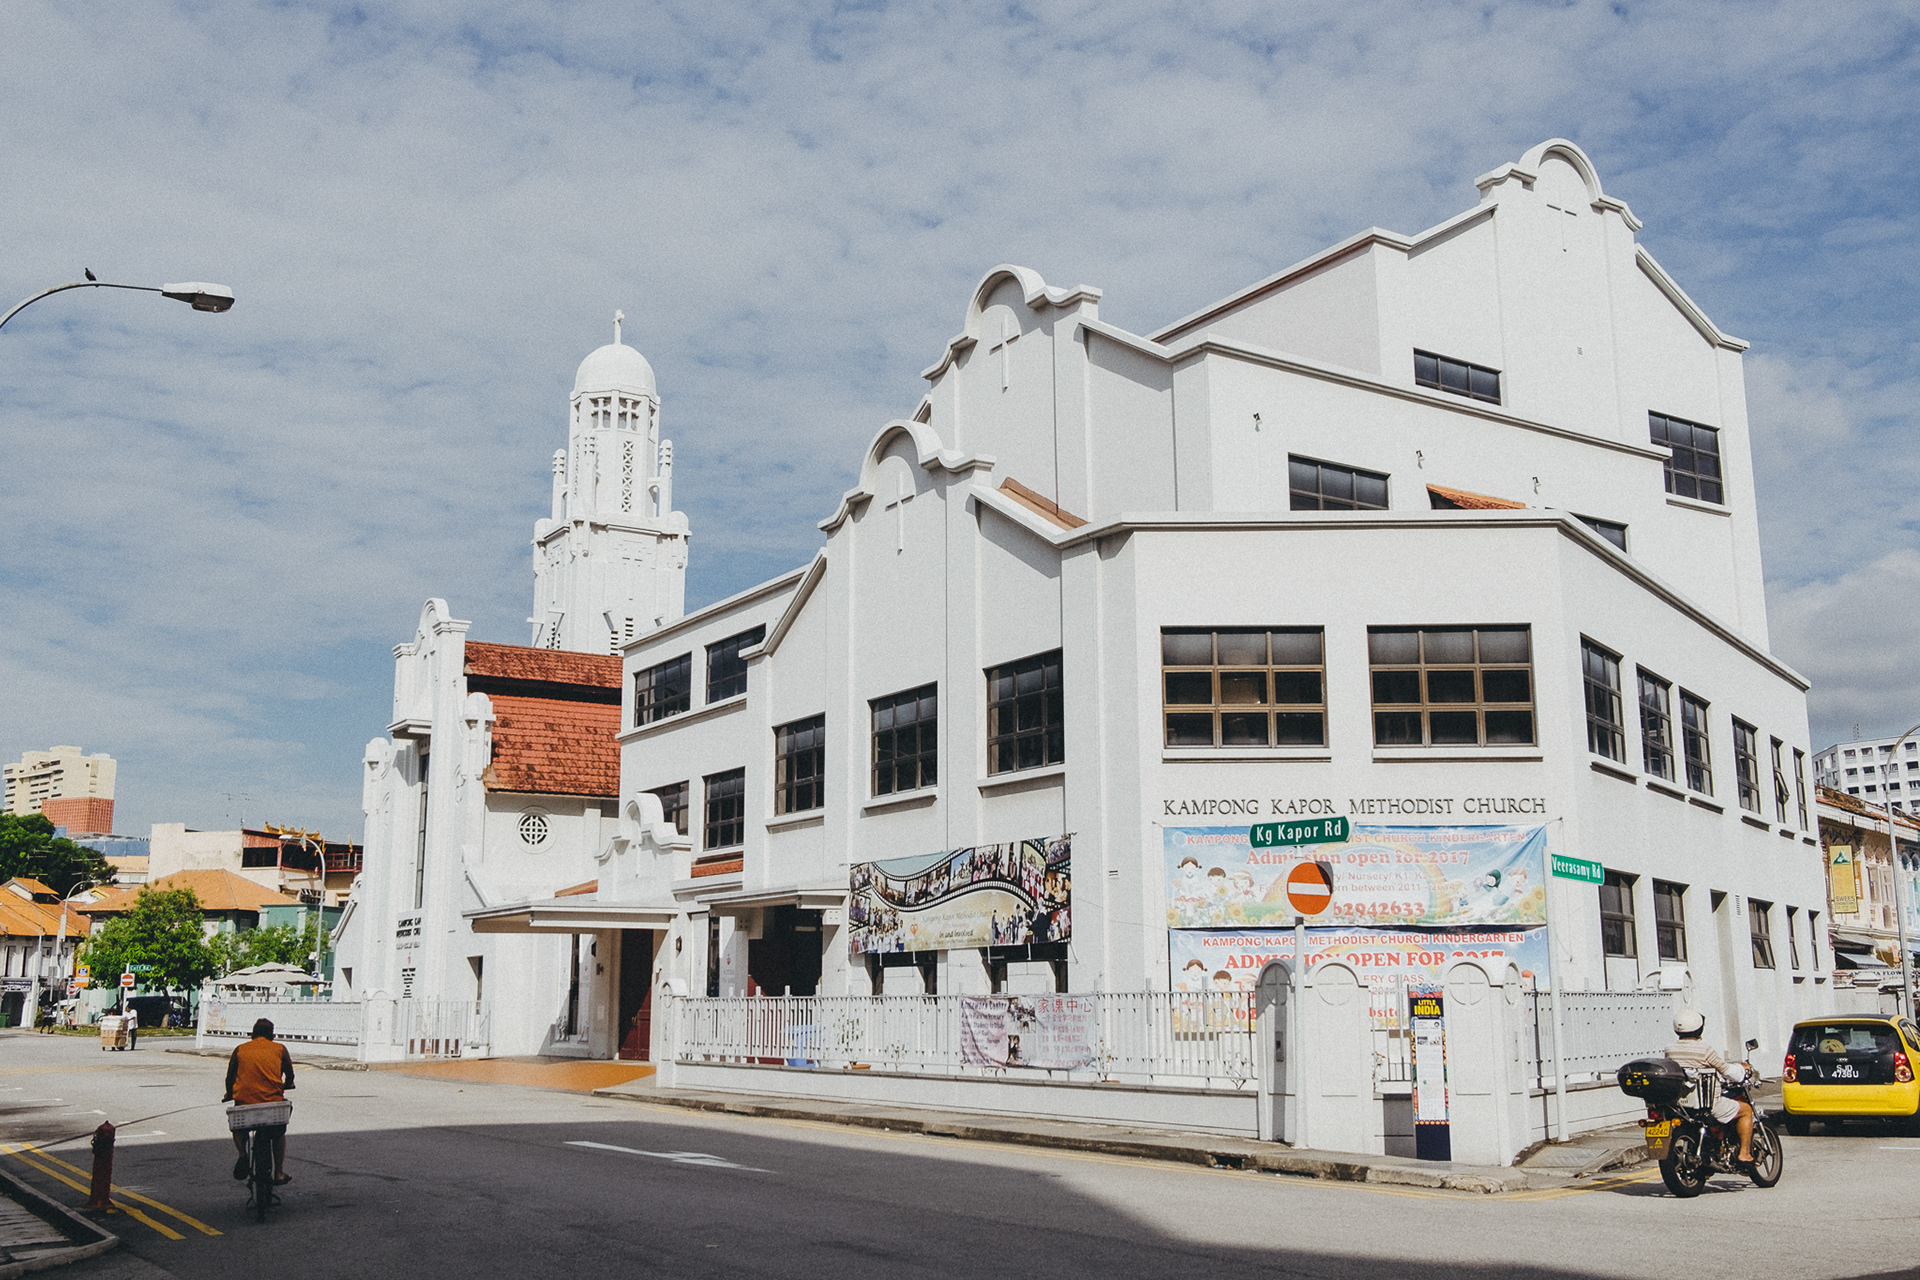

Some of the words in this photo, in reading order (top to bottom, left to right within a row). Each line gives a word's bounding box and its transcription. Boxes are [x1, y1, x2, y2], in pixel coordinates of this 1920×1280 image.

[1163, 799, 1259, 815] KAMPONG
[1271, 799, 1336, 815] KAPOR
[1350, 798, 1453, 814] METHODIST
[1463, 797, 1546, 813] CHURCH
[1187, 834, 1249, 844] KAMPONG
[1375, 834, 1427, 843] CHURCH
[1430, 833, 1526, 843] KINDERGARTEN
[1256, 826, 1272, 845] Kg
[1278, 824, 1318, 843] Kapor
[1325, 820, 1341, 837] Rd
[1246, 850, 1341, 865] Admision
[1347, 853, 1390, 867] open
[1396, 851, 1421, 864] for
[1429, 851, 1469, 865] 2017
[1552, 856, 1590, 880] Veerasamy
[1592, 863, 1601, 879] Rd
[1352, 883, 1395, 892] between
[1203, 937, 1261, 947] KAMPONG
[1265, 936, 1298, 946] KAPO
[1309, 935, 1376, 945] METHODIST
[1380, 934, 1429, 943] CHURCH
[1432, 933, 1524, 943] KINDERGARTEN
[1407, 951, 1445, 966] FOR
[1388, 974, 1425, 983] CASS
[1038, 997, 1093, 1013] 家课中心
[1414, 1005, 1441, 1016] INDIA
